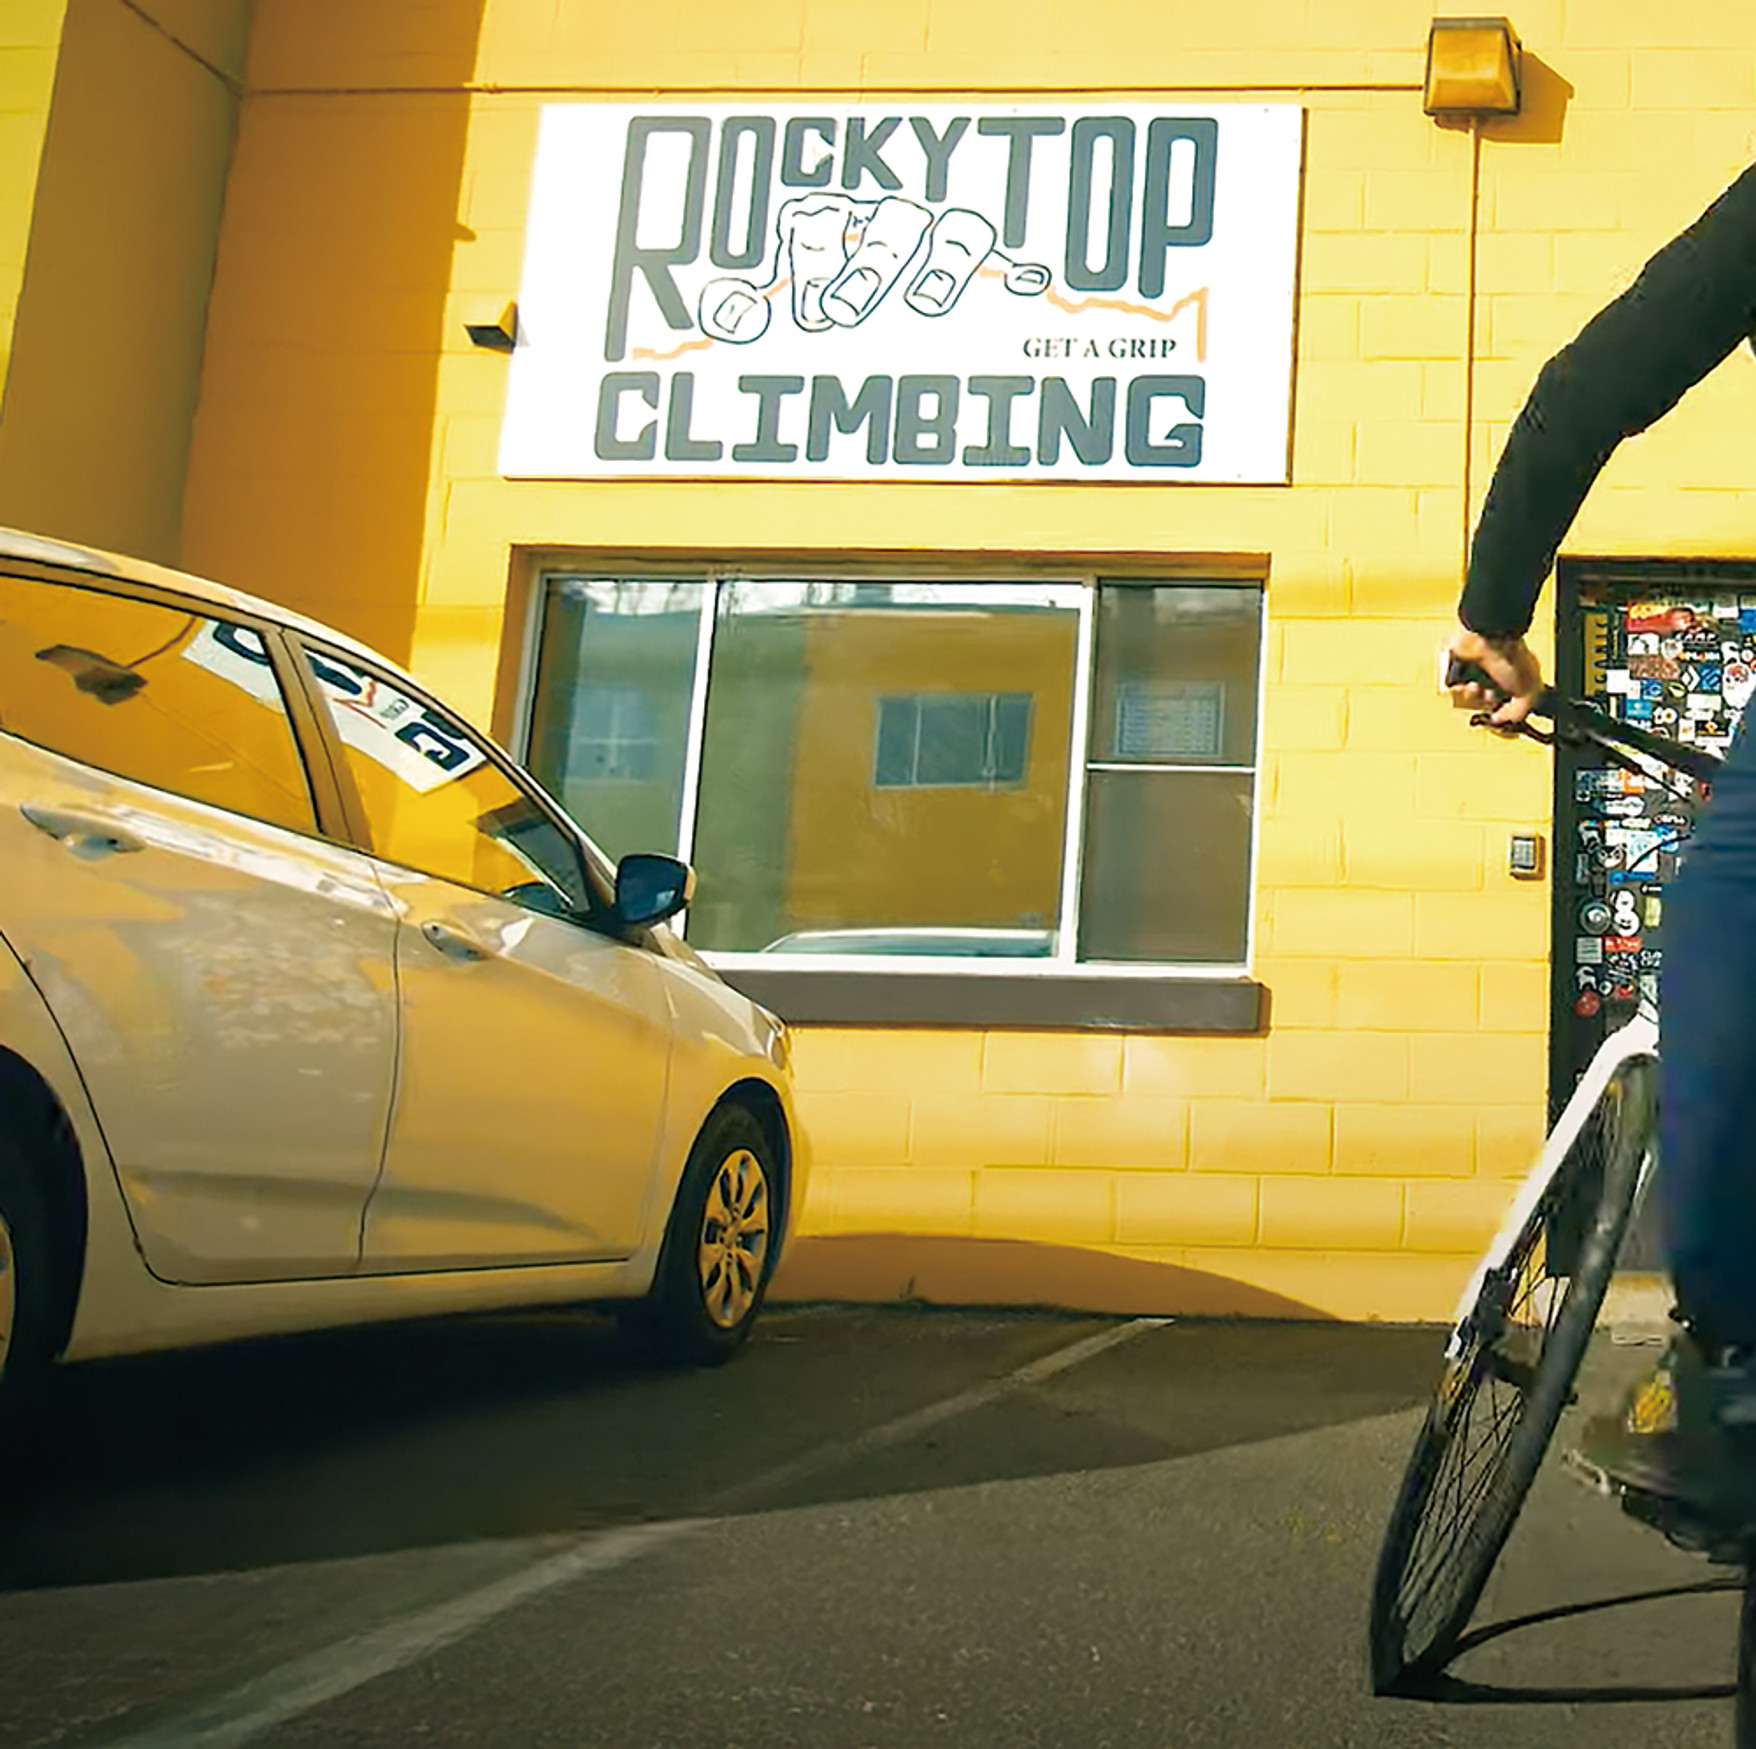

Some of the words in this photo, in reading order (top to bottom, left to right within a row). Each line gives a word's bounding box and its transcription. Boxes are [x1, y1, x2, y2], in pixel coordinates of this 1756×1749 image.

[1023, 338, 1078, 358] GET
[1083, 338, 1100, 358] A
[1108, 338, 1177, 358] GRIP
[594, 371, 1206, 467] CLIMBING
